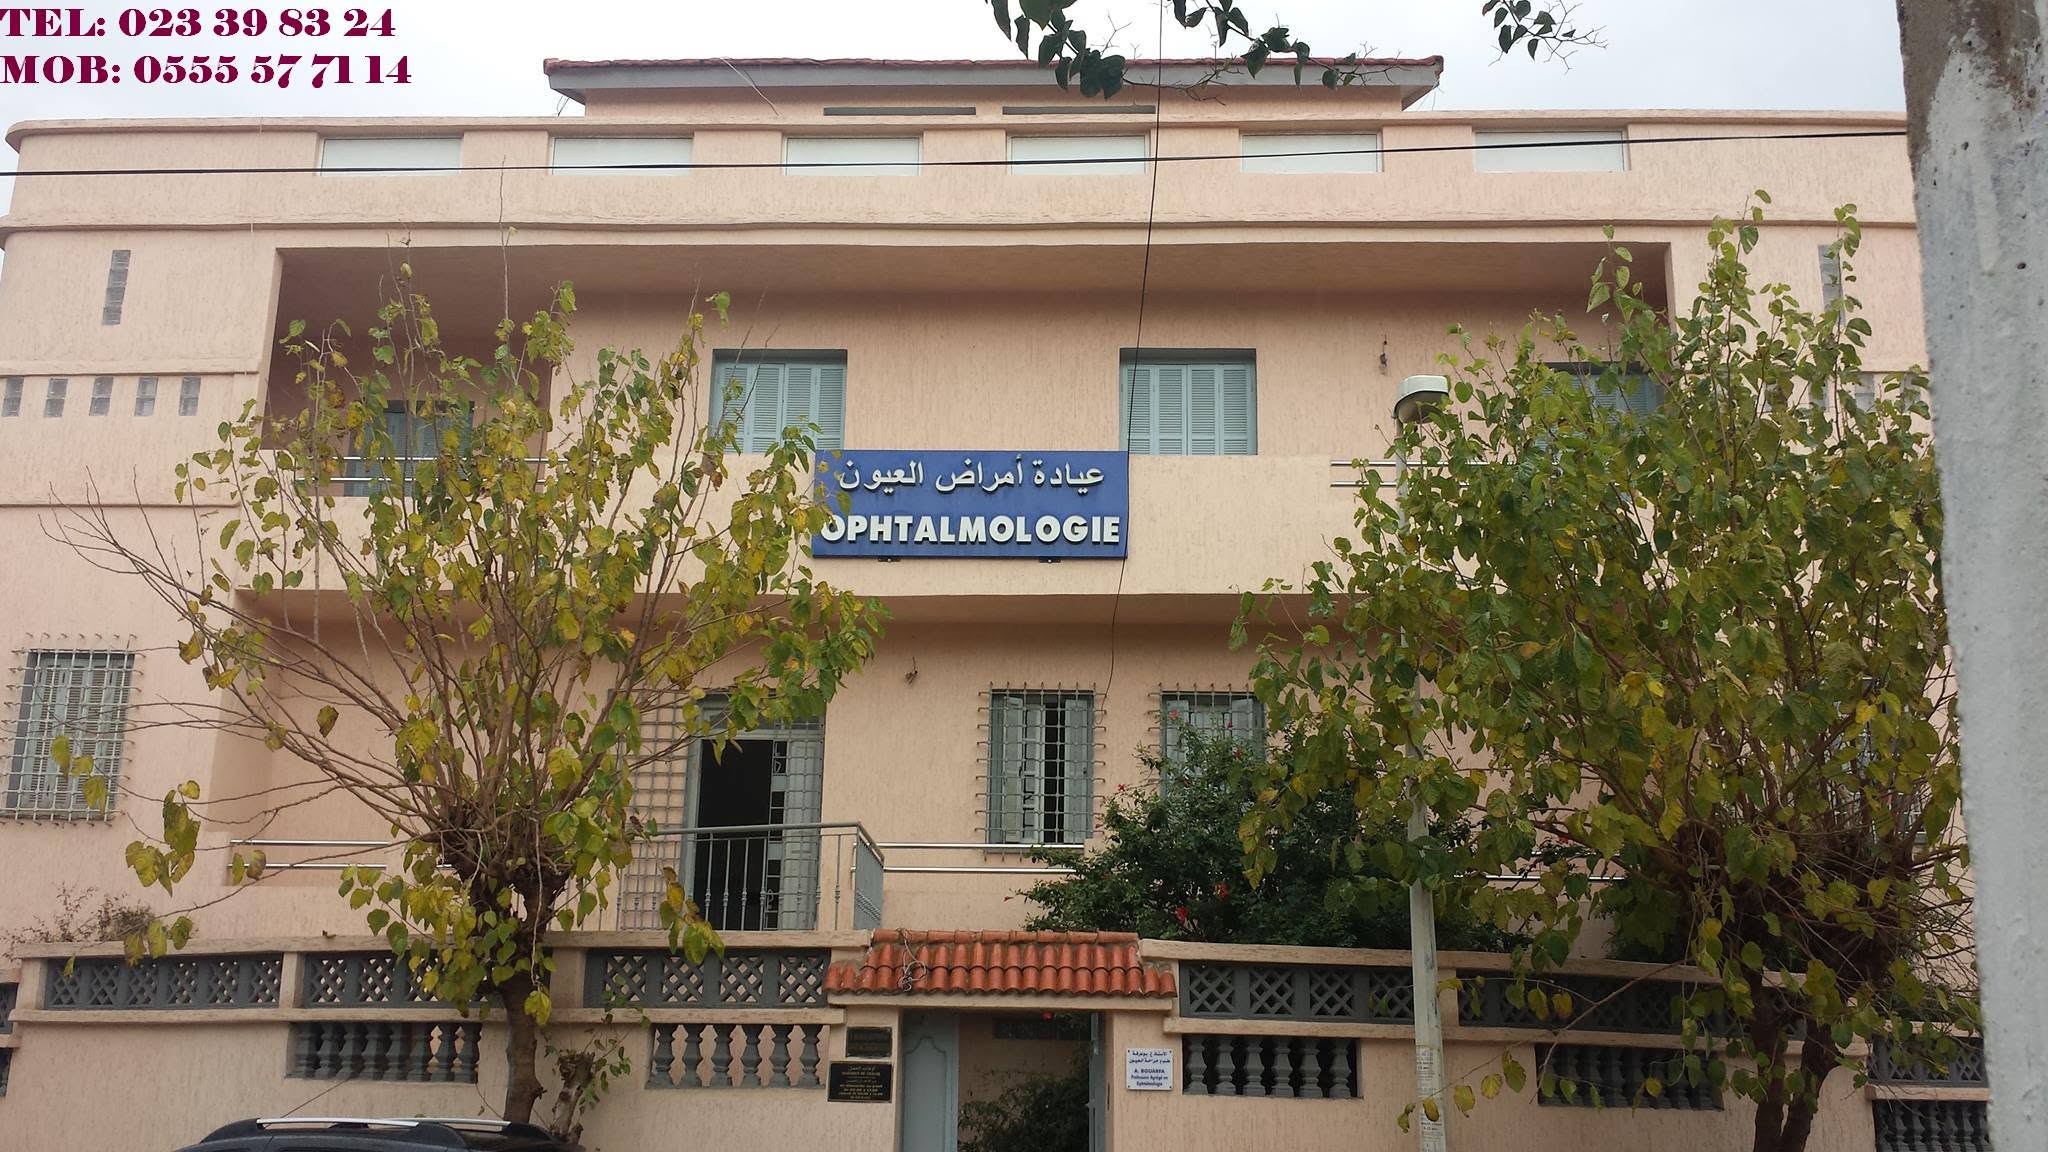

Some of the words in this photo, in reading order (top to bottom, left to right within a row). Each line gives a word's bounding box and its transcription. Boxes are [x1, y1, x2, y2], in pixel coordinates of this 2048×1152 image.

[839, 460, 924, 496] العيون
[935, 454, 1022, 492] أمراض
[1032, 459, 1104, 494] عيادة
[821, 515, 1120, 543] OPHTALMOLOGIE
